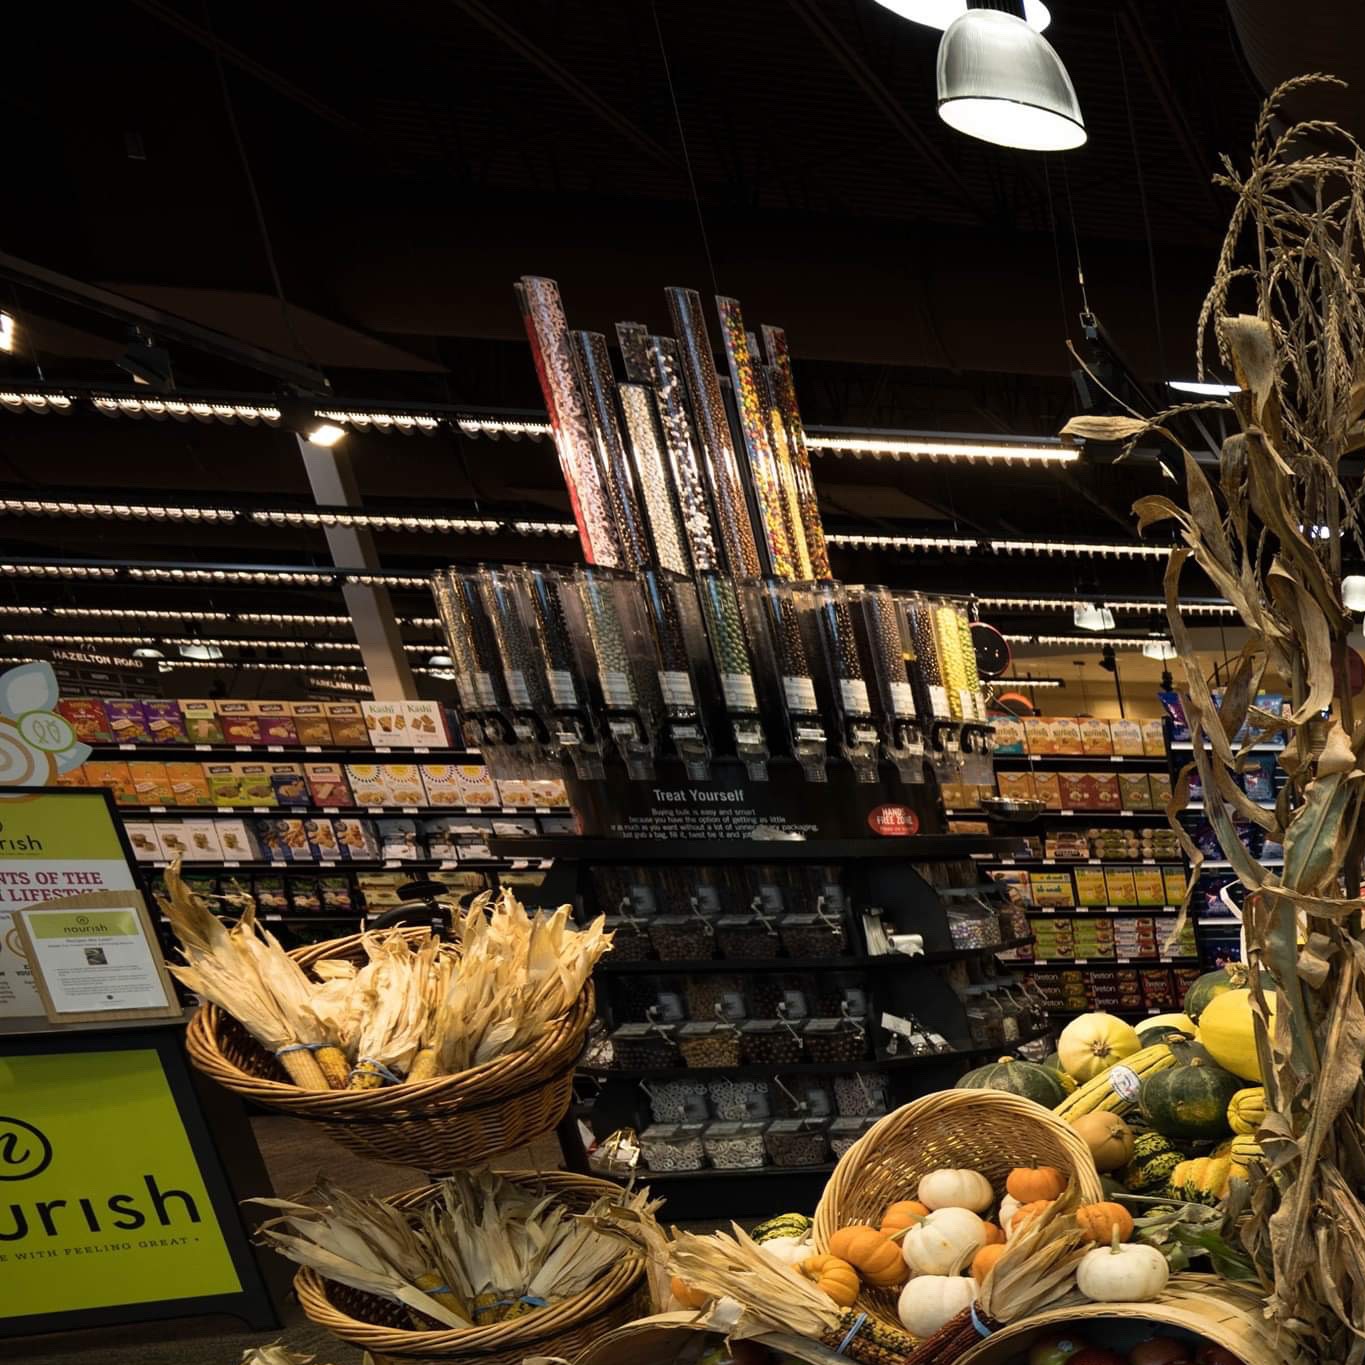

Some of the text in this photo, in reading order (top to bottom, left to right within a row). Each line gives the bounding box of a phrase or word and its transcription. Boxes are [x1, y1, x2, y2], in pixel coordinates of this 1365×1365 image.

[52, 649, 144, 669] HAZELTON ROAD
[368, 704, 395, 714] Kashi
[407, 703, 432, 713] Kashi
[653, 789, 745, 802] Treat Yourself
[876, 815, 895, 825] FREE
[35, 872, 63, 885] OF
[63, 871, 104, 885] THE
[63, 922, 108, 934] nourish
[1089, 970, 1115, 981] Breton
[1091, 983, 1117, 994] Breton
[1145, 980, 1168, 990] Breton
[1094, 996, 1120, 1007] Breton
[15, 1237, 187, 1262] WITH FEELING GREAT
